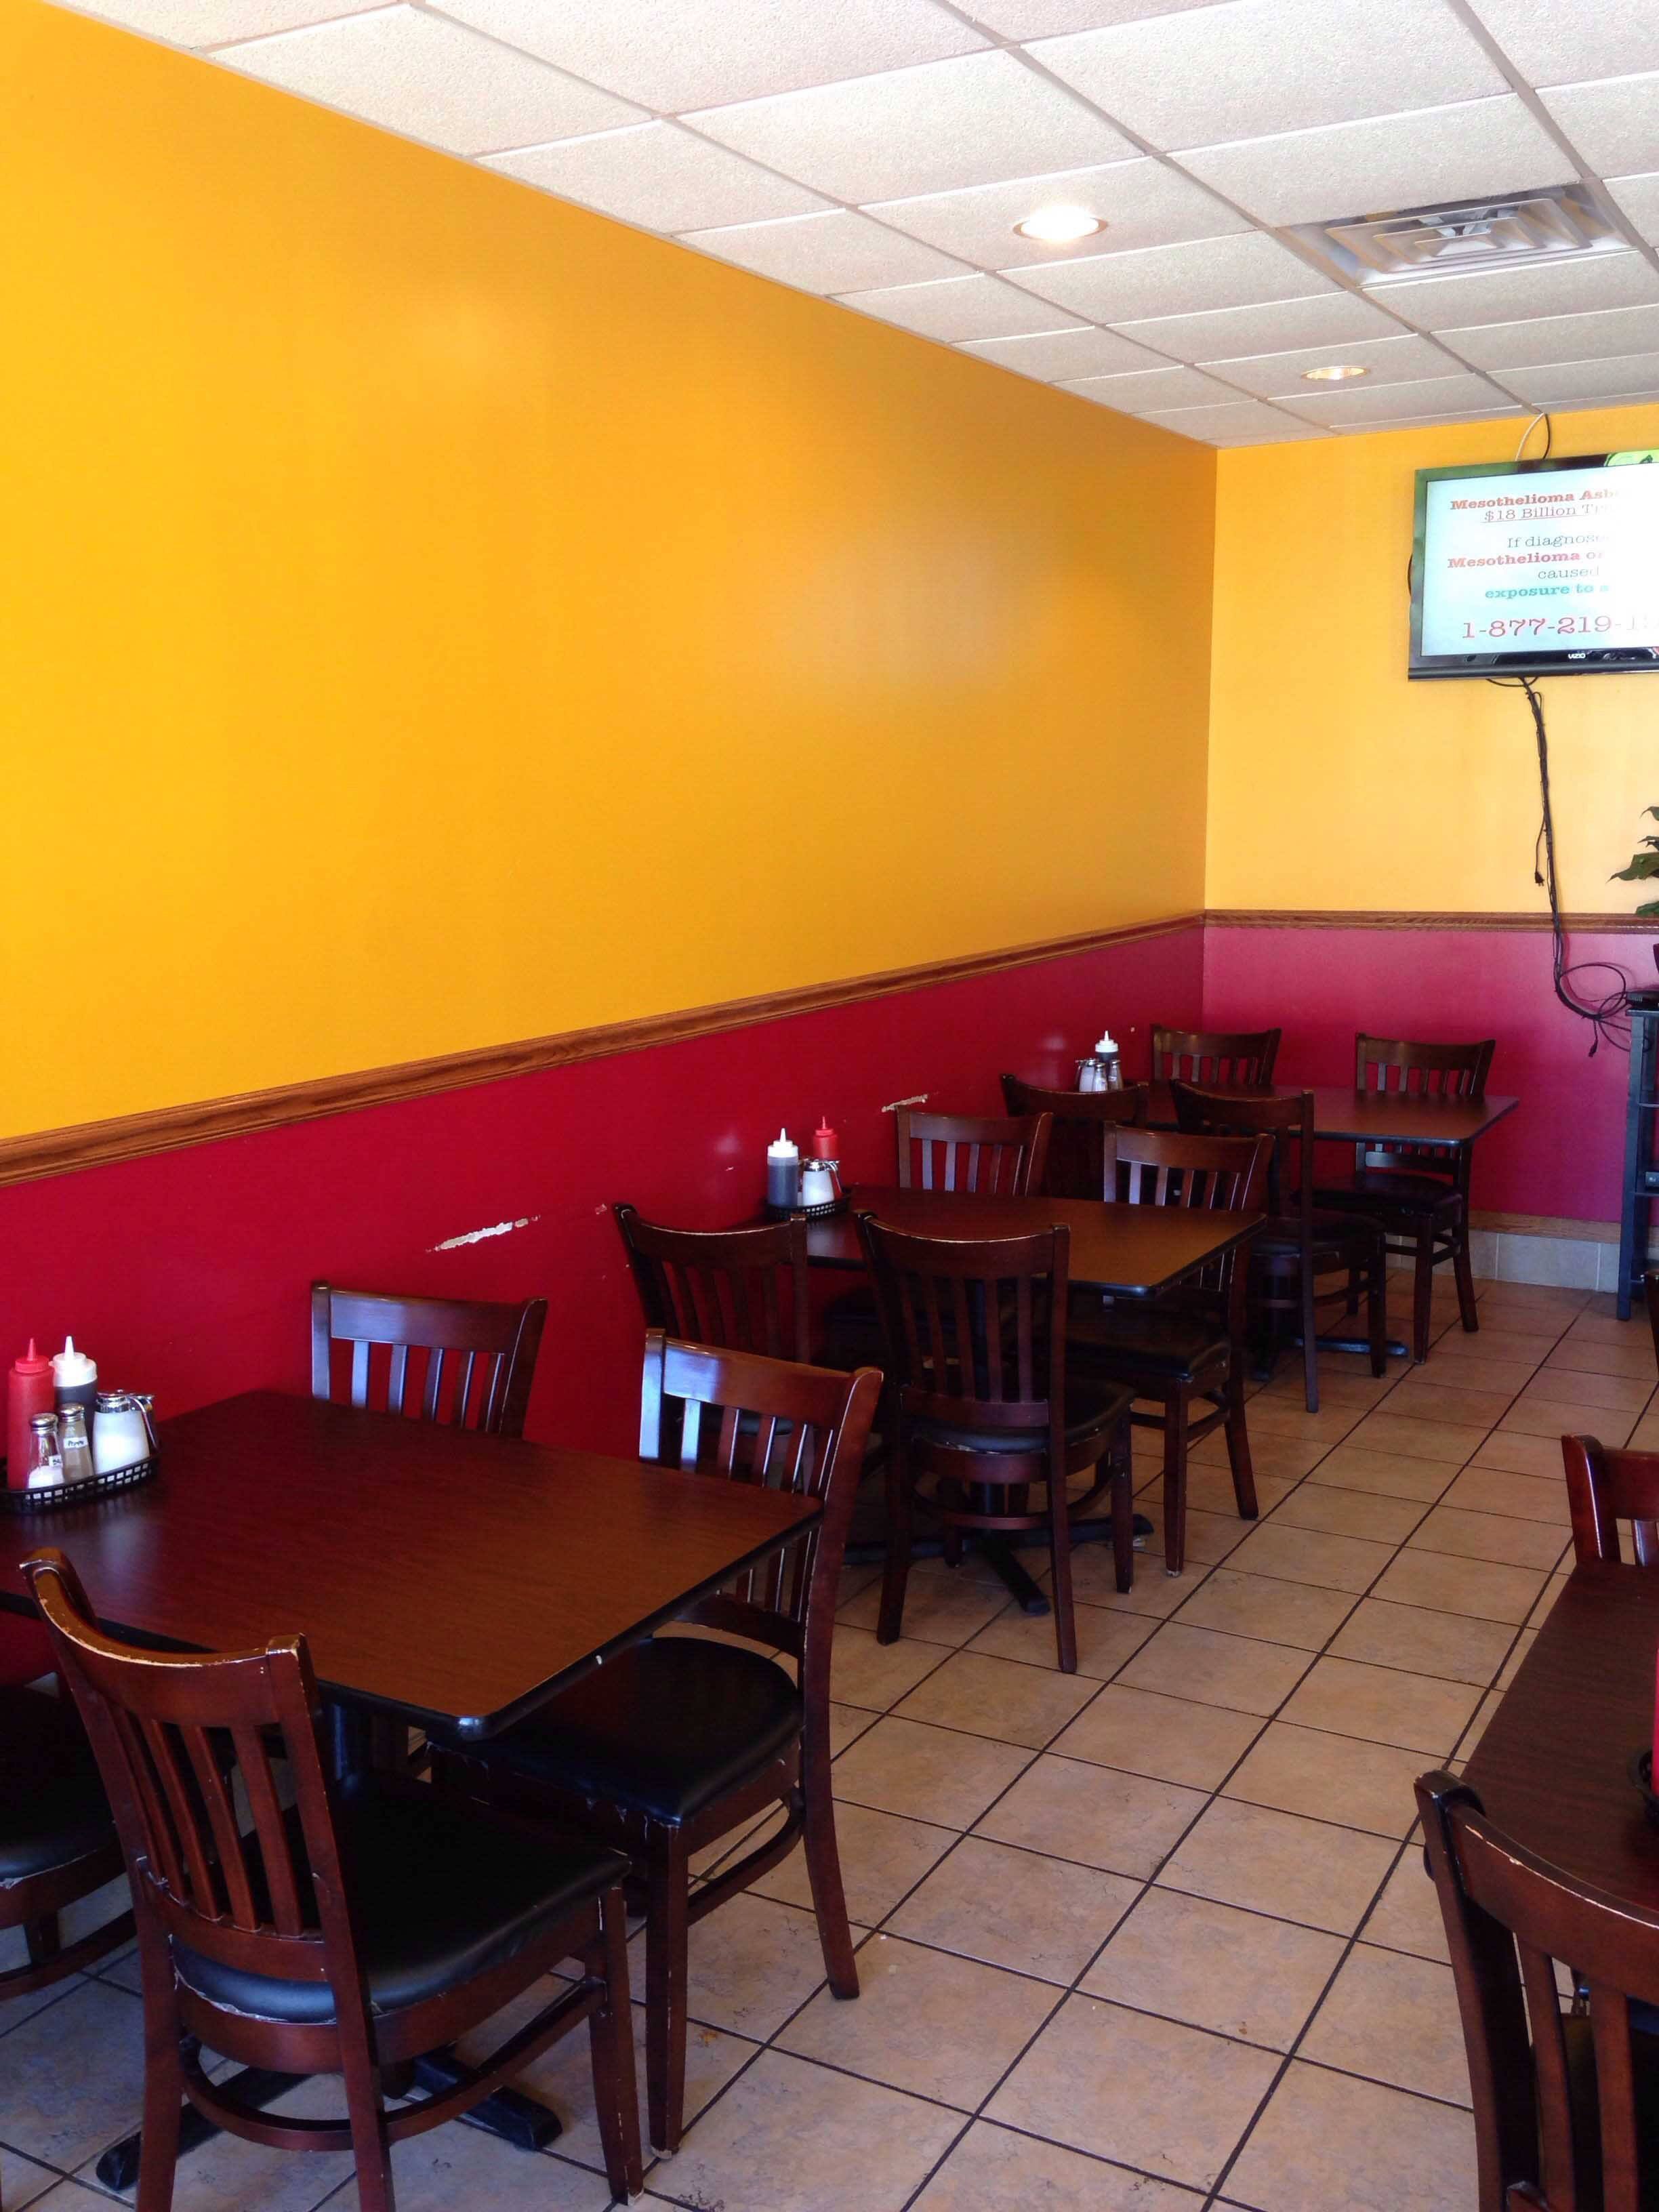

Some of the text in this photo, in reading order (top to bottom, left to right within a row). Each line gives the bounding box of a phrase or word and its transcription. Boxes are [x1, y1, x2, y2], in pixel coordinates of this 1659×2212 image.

[1450, 493, 1574, 510] Mesothelioma
[1484, 508, 1516, 522] $18
[1521, 504, 1577, 519] Billion
[1507, 537, 1520, 548] If
[1448, 552, 1580, 569] Mesothelioma
[1485, 585, 1570, 600] exposure
[1576, 583, 1594, 594] to
